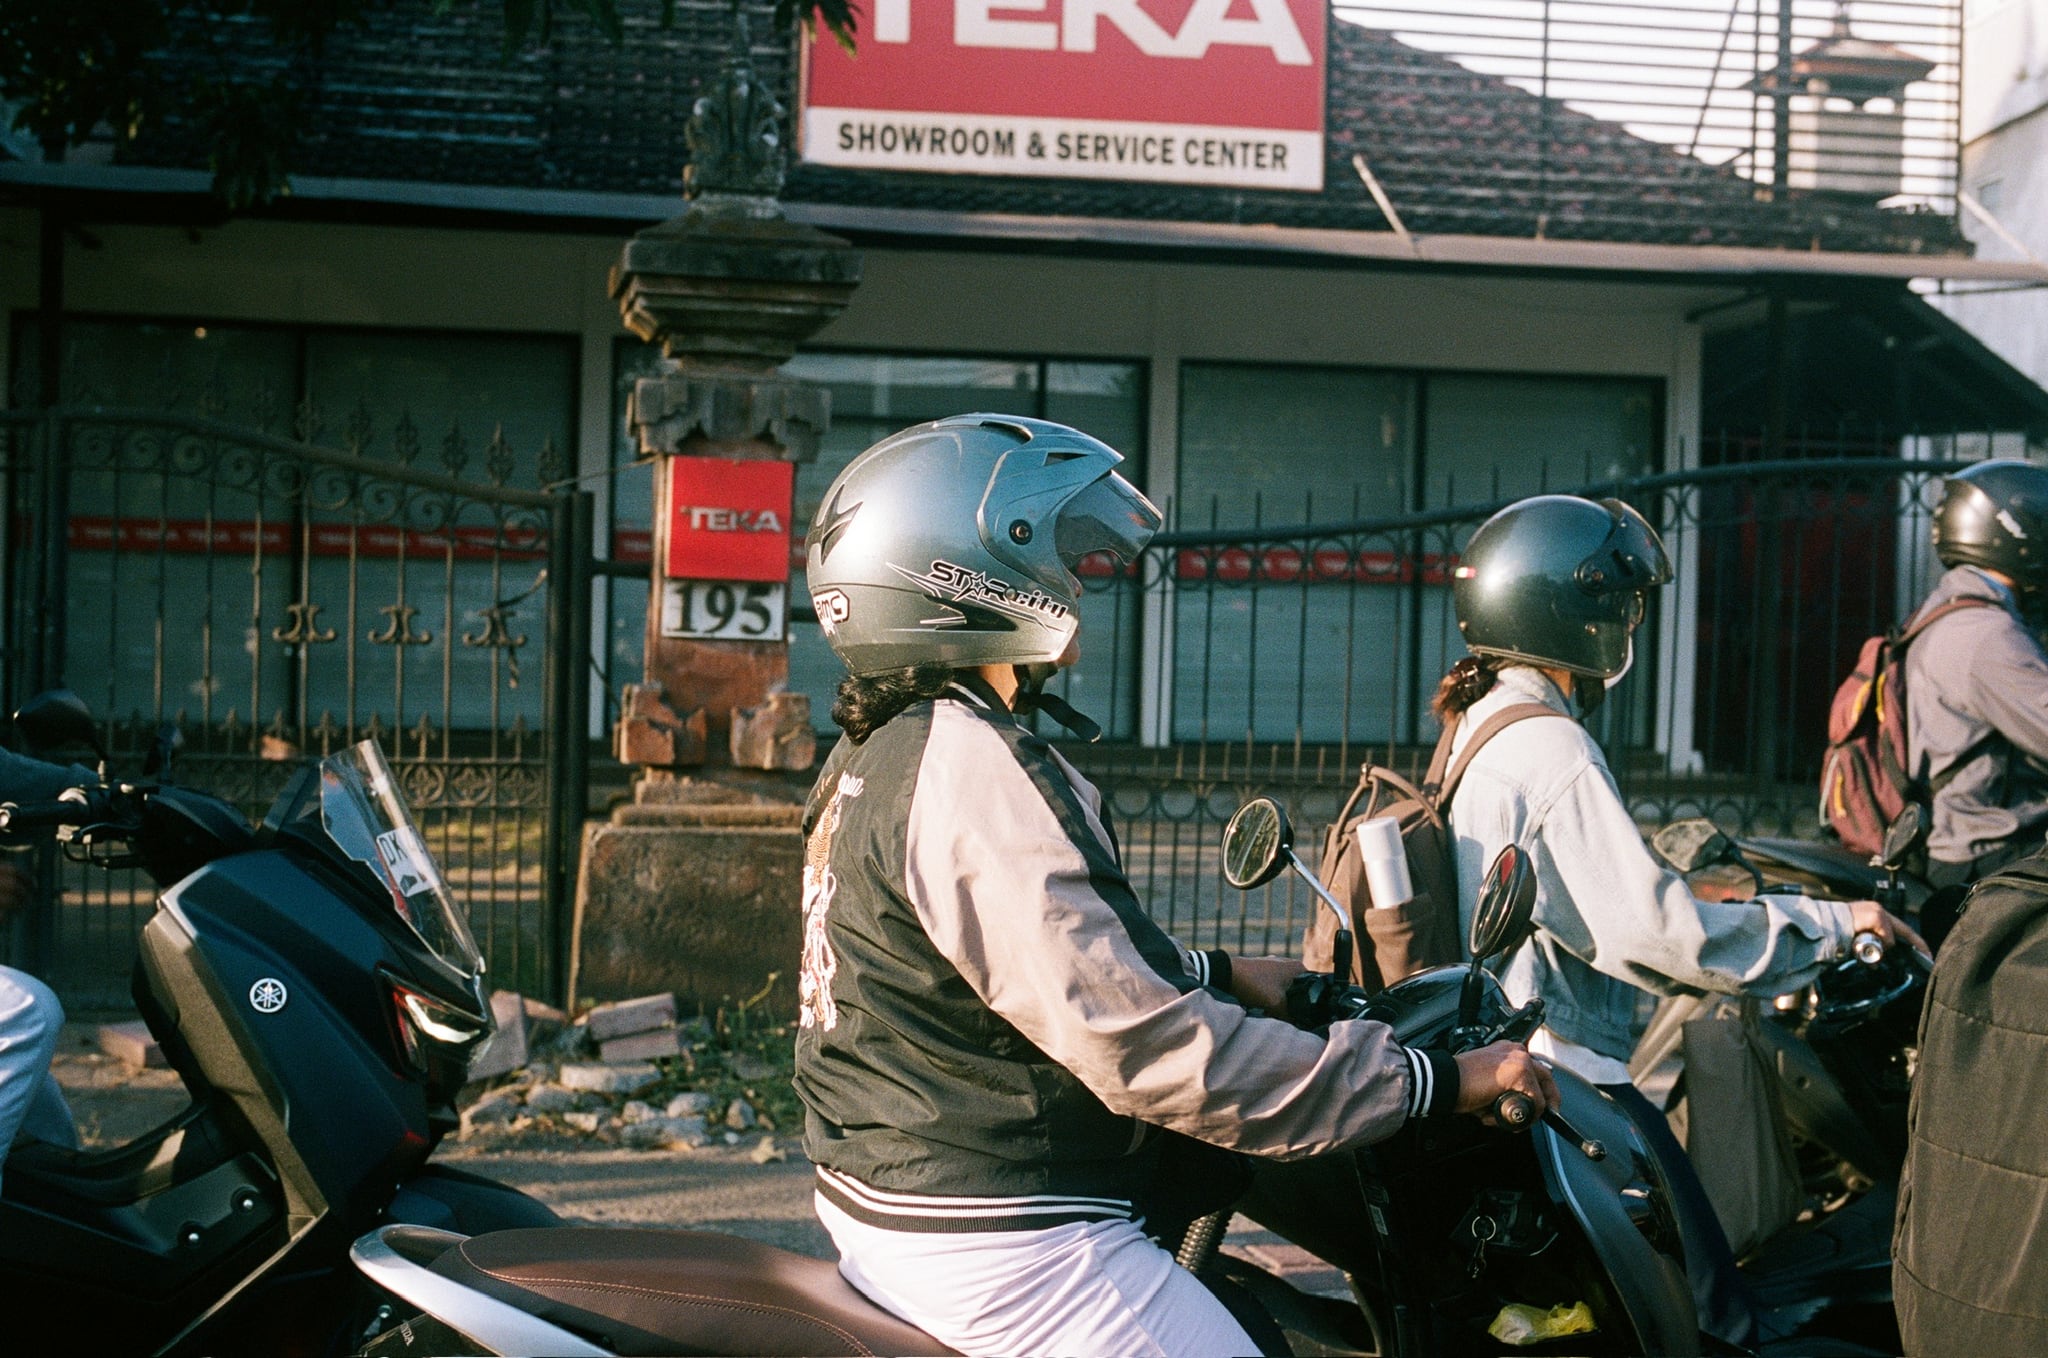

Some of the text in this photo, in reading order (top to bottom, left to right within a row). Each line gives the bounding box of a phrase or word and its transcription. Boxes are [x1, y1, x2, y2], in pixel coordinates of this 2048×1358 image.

[838, 122, 1288, 171] SHOWROOM & SERVICE CENTER
[681, 506, 783, 533] TEKA
[669, 583, 777, 635] 195
[379, 832, 408, 867] DK
